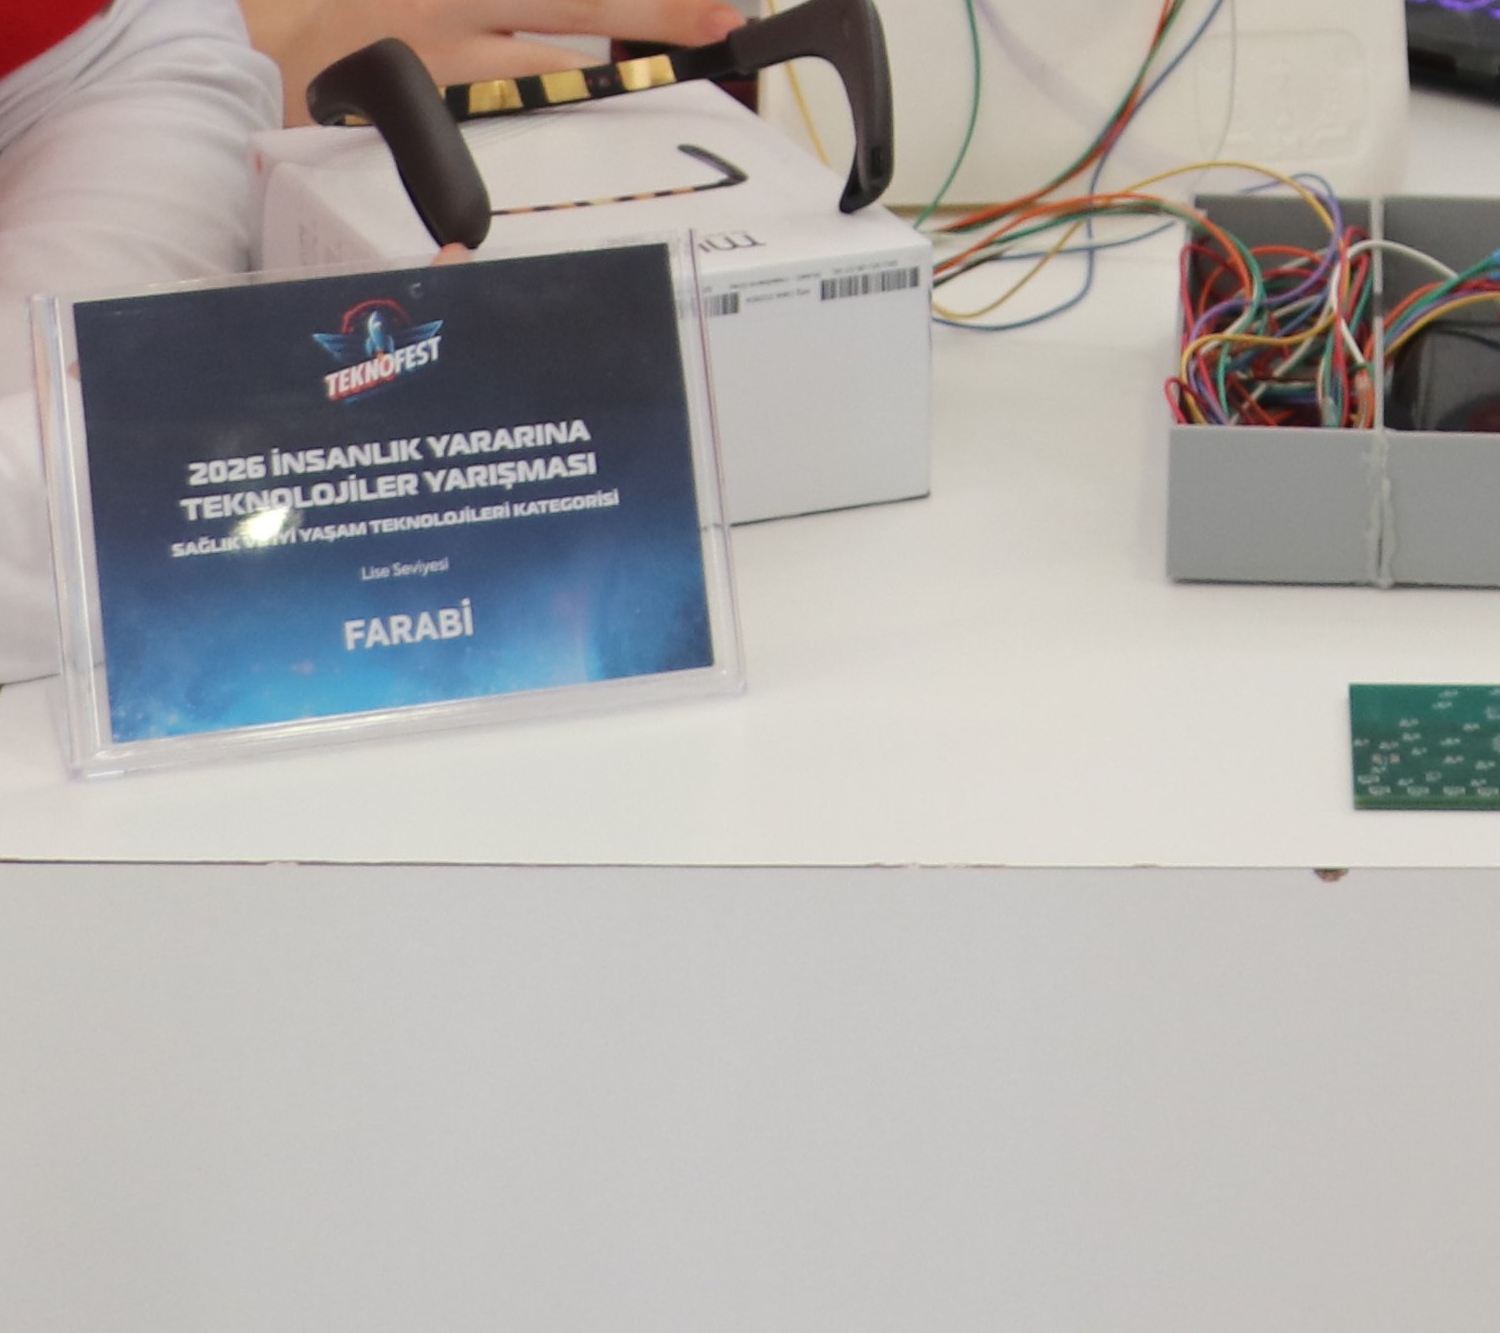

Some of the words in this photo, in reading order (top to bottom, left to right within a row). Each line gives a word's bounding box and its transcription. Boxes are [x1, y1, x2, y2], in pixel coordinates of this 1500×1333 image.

[324, 335, 442, 400] TEKNOFEST
[188, 455, 267, 487] 2026
[272, 436, 422, 477] İNSANLIK
[426, 418, 591, 455] YARARINA
[180, 472, 419, 522] TEKNOLOJİLER
[424, 451, 597, 494] YARIŞMASI
[171, 534, 242, 559] SAĞLIK
[299, 520, 367, 545] YAŞAM
[369, 501, 512, 535] TEKNOLOJİLERİ
[513, 487, 620, 518] KATEGORİSİ
[361, 563, 391, 582] Lise
[392, 556, 450, 580] Seviyesi
[344, 598, 475, 651] FARABİ
